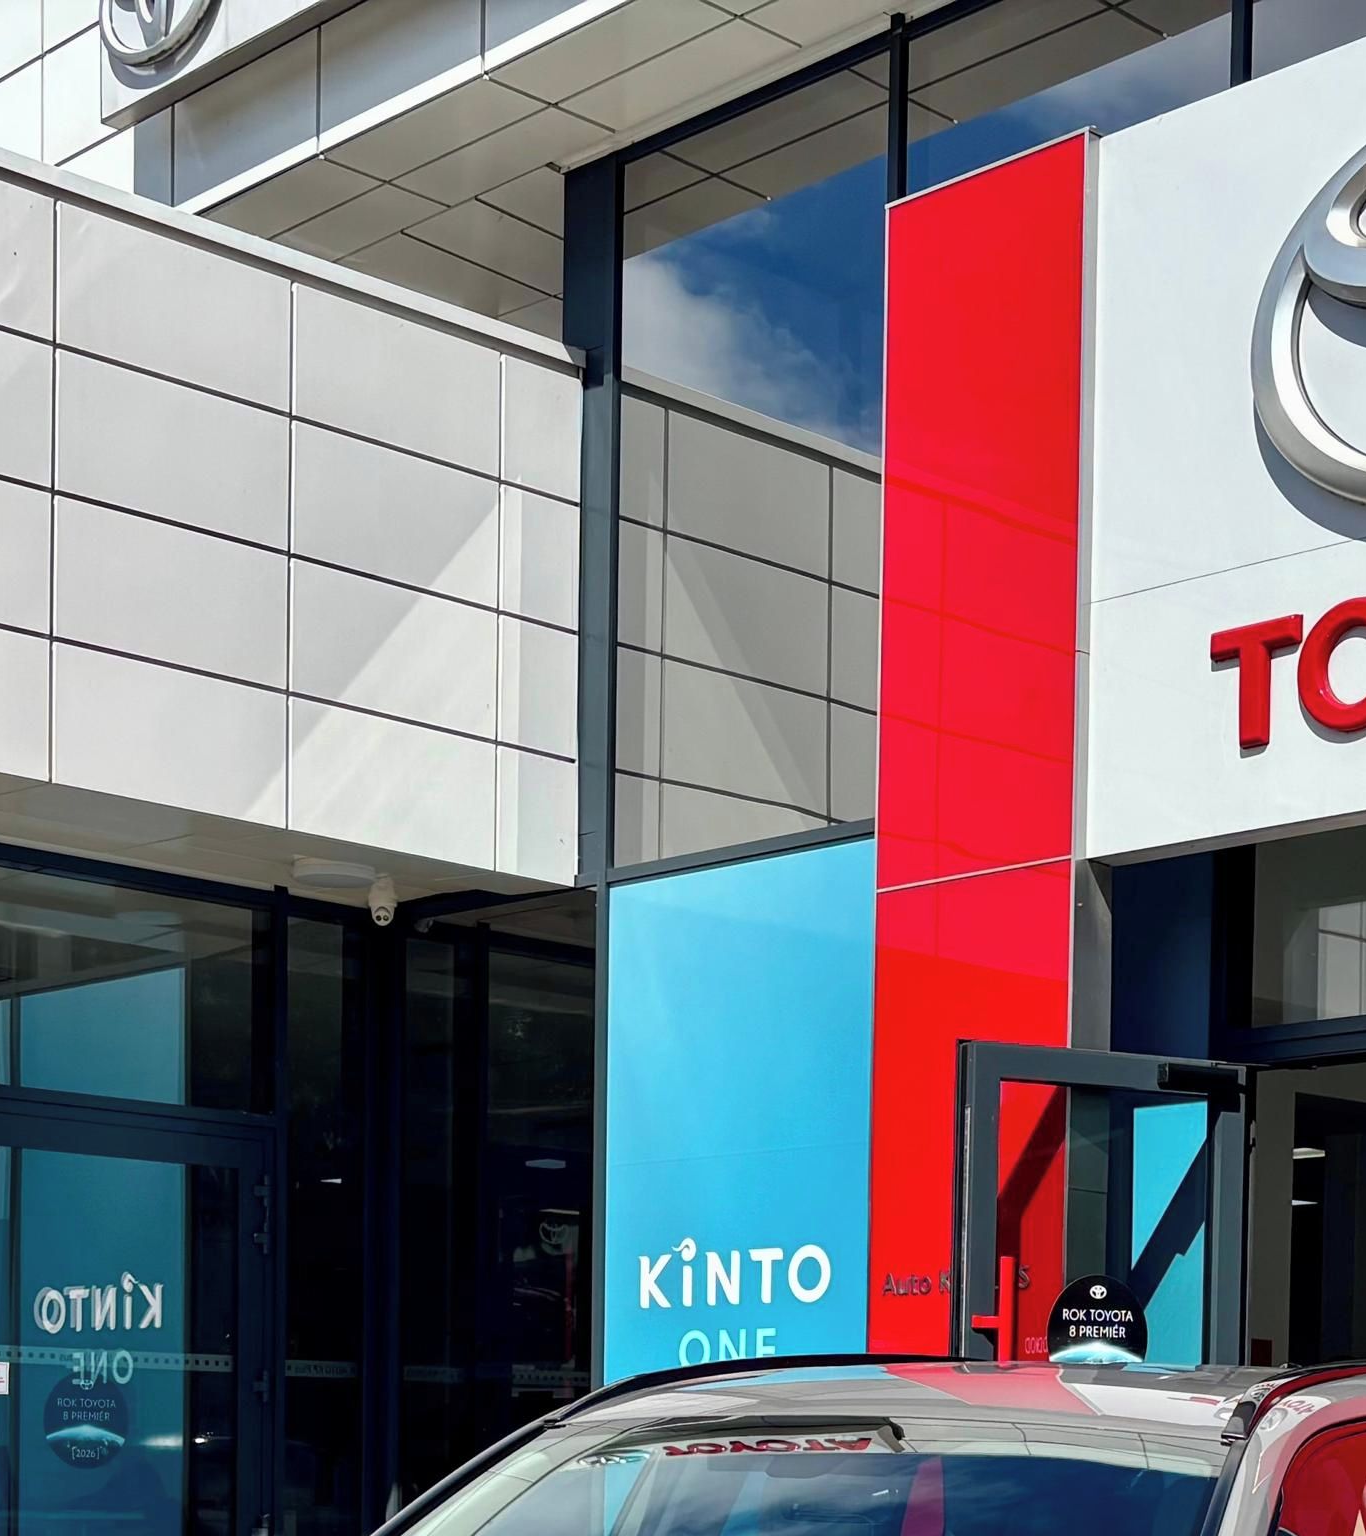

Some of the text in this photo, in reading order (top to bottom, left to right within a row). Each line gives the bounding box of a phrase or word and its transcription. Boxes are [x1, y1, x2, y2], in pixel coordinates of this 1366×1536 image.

[882, 1273, 932, 1296] Auto
[1062, 1308, 1133, 1323] ROK TOYOTA
[1069, 1324, 1126, 1338] 8 PREMIÉR
[678, 1327, 777, 1367] ONE
[57, 1397, 116, 1409] ROK TOYOTA
[71, 1409, 110, 1421] PREMIÉR
